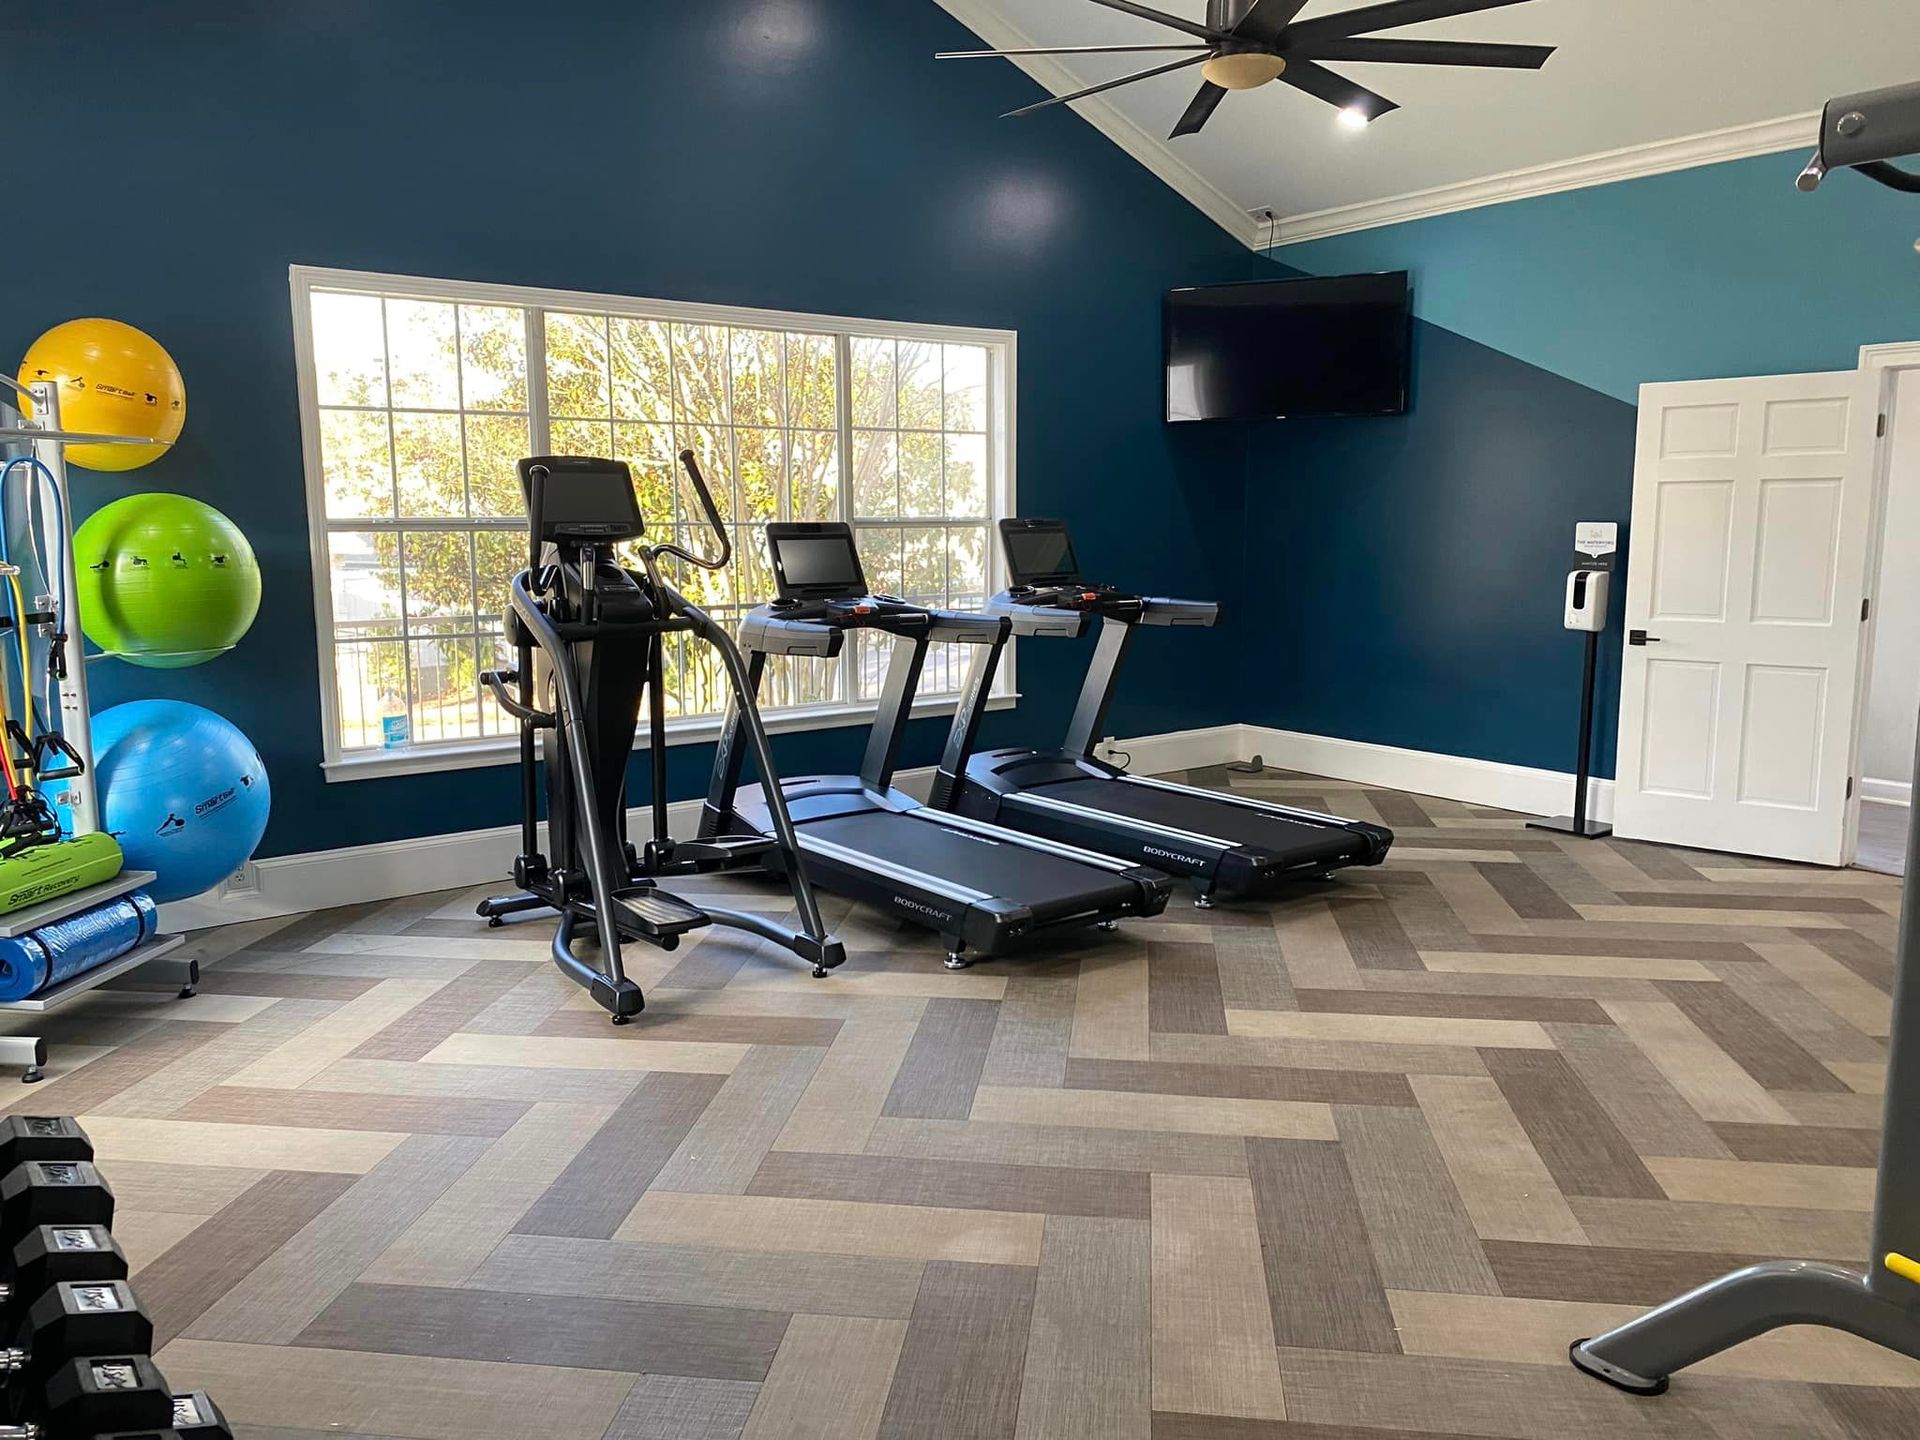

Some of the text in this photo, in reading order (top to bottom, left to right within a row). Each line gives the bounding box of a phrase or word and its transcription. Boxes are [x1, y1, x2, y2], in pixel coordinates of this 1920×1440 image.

[1143, 845, 1206, 867] BODYCRAFT
[8, 886, 43, 906] Smart
[894, 895, 952, 921] BODYCRAFT
